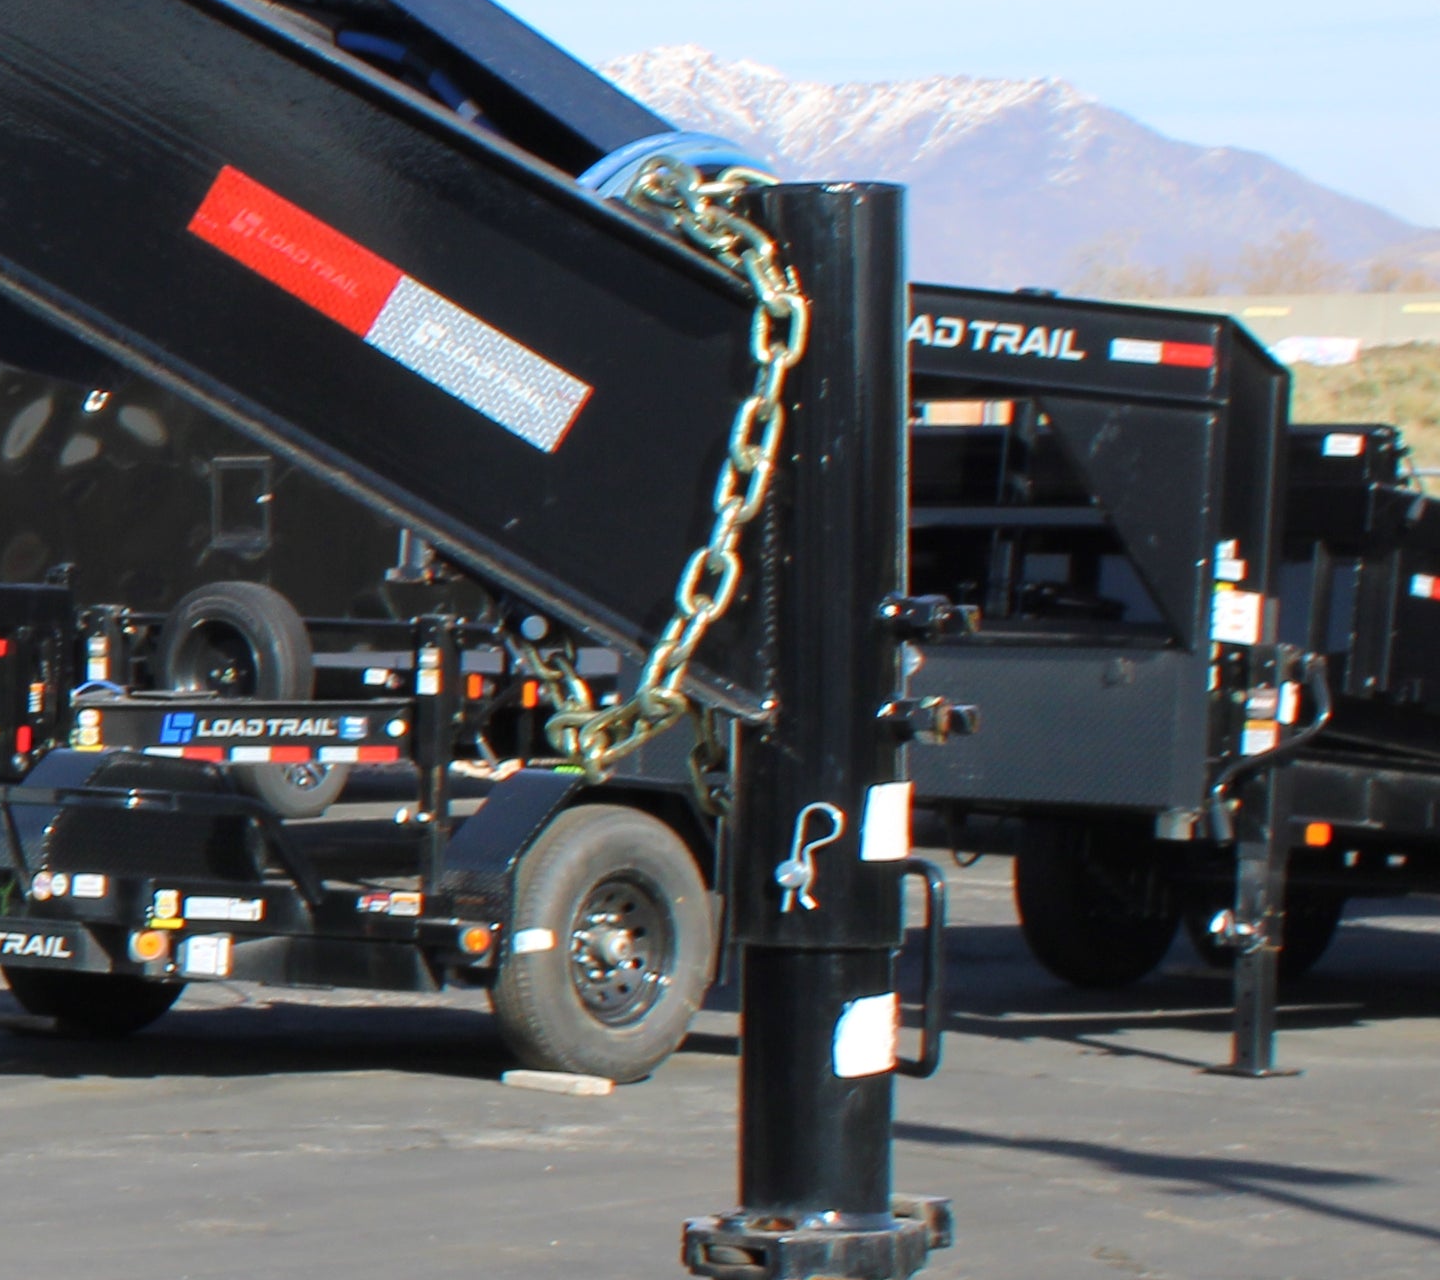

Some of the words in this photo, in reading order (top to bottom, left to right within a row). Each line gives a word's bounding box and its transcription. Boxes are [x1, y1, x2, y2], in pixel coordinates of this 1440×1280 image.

[906, 314, 966, 349] AD
[968, 320, 1088, 361] TRAIL
[196, 718, 267, 738] LOAD
[265, 718, 338, 738] TRAIL
